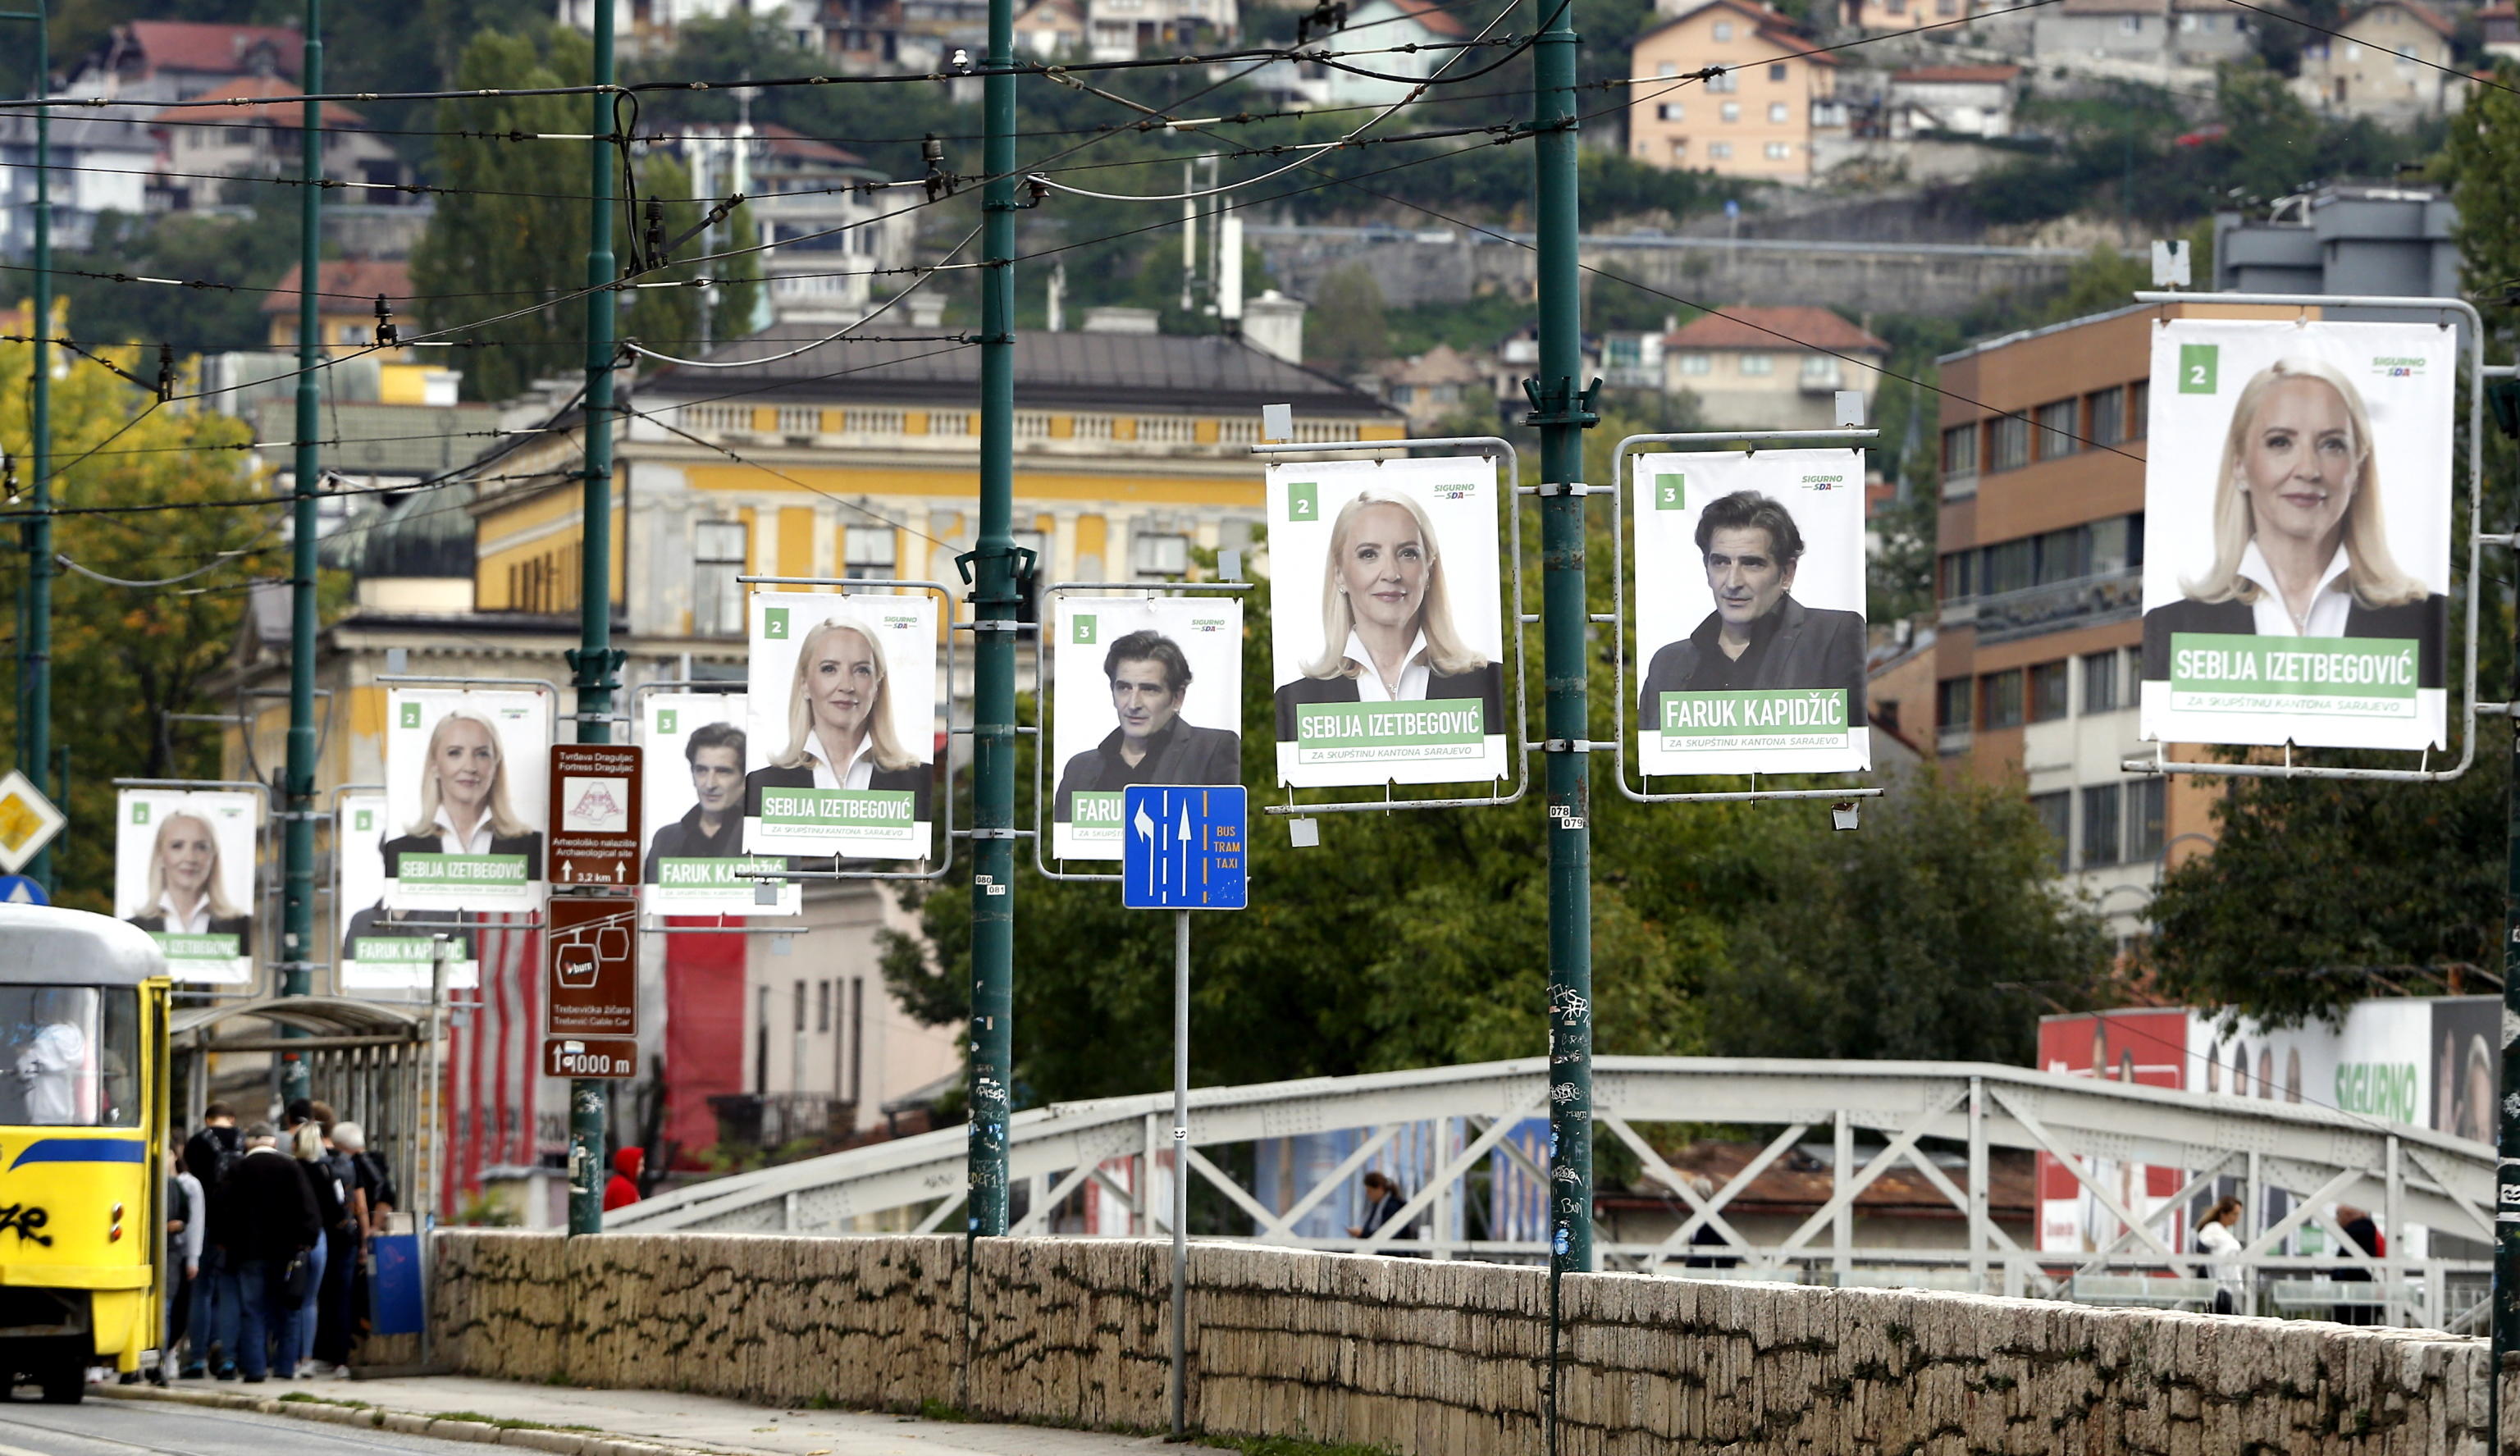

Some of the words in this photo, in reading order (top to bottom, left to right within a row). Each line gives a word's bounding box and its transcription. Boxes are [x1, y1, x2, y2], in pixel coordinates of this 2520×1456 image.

[2372, 357, 2426, 367] SIGURNO
[2190, 366, 2206, 385] 2
[2387, 367, 2410, 377] SDA
[1802, 475, 1843, 483] SIGURNO
[1434, 483, 1475, 492] SIGURNO
[1445, 491, 1464, 500] SDA
[1664, 488, 1676, 502] 3
[1297, 499, 1309, 513] 2
[771, 621, 782, 633] 2
[1080, 626, 1089, 638] 3
[2176, 649, 2258, 680] SEBIJA
[2266, 649, 2413, 685] IZETBEGOVIĆ
[1666, 699, 1737, 728] FARUK
[1744, 691, 1842, 727] KAPIDŽIĆ
[2187, 696, 2203, 706] ZA
[2208, 696, 2272, 708] SKUPŠTINU
[2276, 699, 2332, 710] KANTONA
[2337, 701, 2400, 712] SARAJEVO
[406, 714, 415, 723] 2
[663, 719, 671, 729] 3
[1302, 714, 1363, 739] SEBIJA
[1369, 705, 1480, 737] IZETBEGOVIĆ
[1669, 739, 1682, 747] ZA
[1686, 737, 1737, 747] SKUPŠTINU
[1741, 737, 1787, 746] KANTONA
[1790, 737, 1839, 746] SARAJEVO
[595, 753, 634, 763] Draguljac
[1312, 751, 1324, 760] ZA
[1327, 749, 1376, 759] SKUPŠTINU
[1378, 748, 1421, 757] KANTONA
[1424, 746, 1472, 755] SARAJEVO
[559, 762, 593, 771] Fortress
[594, 763, 634, 773] Draguljac
[765, 796, 815, 816] SEBIJA
[819, 796, 911, 819] IZETBEGOVIĆ
[1076, 798, 1122, 821] FARU
[1551, 807, 1569, 816] 078
[1564, 819, 1582, 828] 079
[864, 828, 903, 837] SARAJEVO
[1217, 826, 1236, 837] BUS
[1213, 842, 1241, 852] TRAM
[556, 848, 617, 858] Archaeological
[1216, 858, 1238, 869] TAXI
[403, 860, 445, 878] SEBIJA
[447, 860, 525, 879] IZETBEGOVIĆ
[662, 864, 711, 883] FARUK
[578, 873, 593, 882] 3,2
[596, 873, 611, 882] km
[976, 875, 992, 883] 080
[358, 943, 399, 958] FARUK
[589, 1017, 613, 1025] Cable
[615, 1017, 630, 1025] Car
[569, 1054, 610, 1074] 1000
[616, 1059, 630, 1074] m
[2335, 1061, 2415, 1125] SIGURNO
